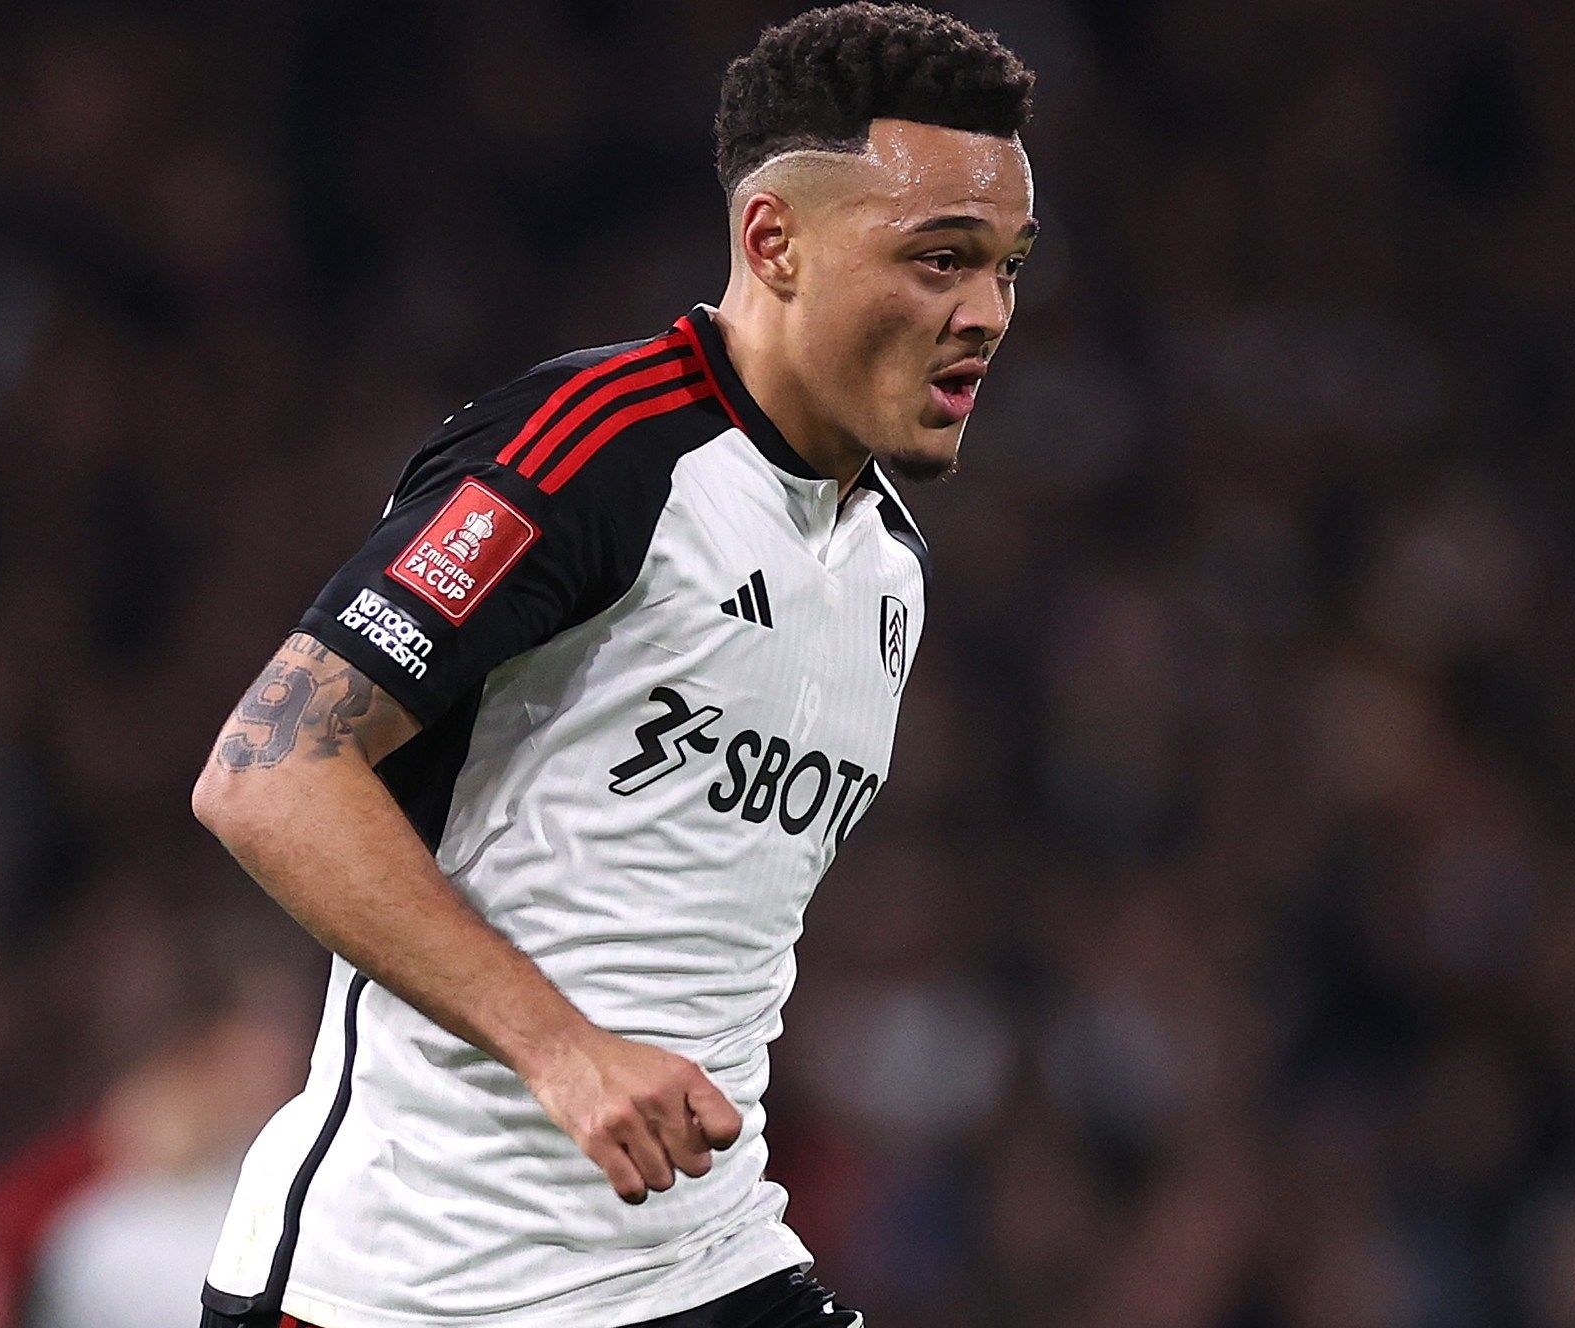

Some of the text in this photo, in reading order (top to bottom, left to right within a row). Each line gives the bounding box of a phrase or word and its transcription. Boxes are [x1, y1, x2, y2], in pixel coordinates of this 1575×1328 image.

[405, 554, 467, 600] FA CUP
[417, 541, 476, 590] Emirates
[352, 589, 382, 617] No
[376, 606, 433, 657] room
[361, 622, 428, 680] racism
